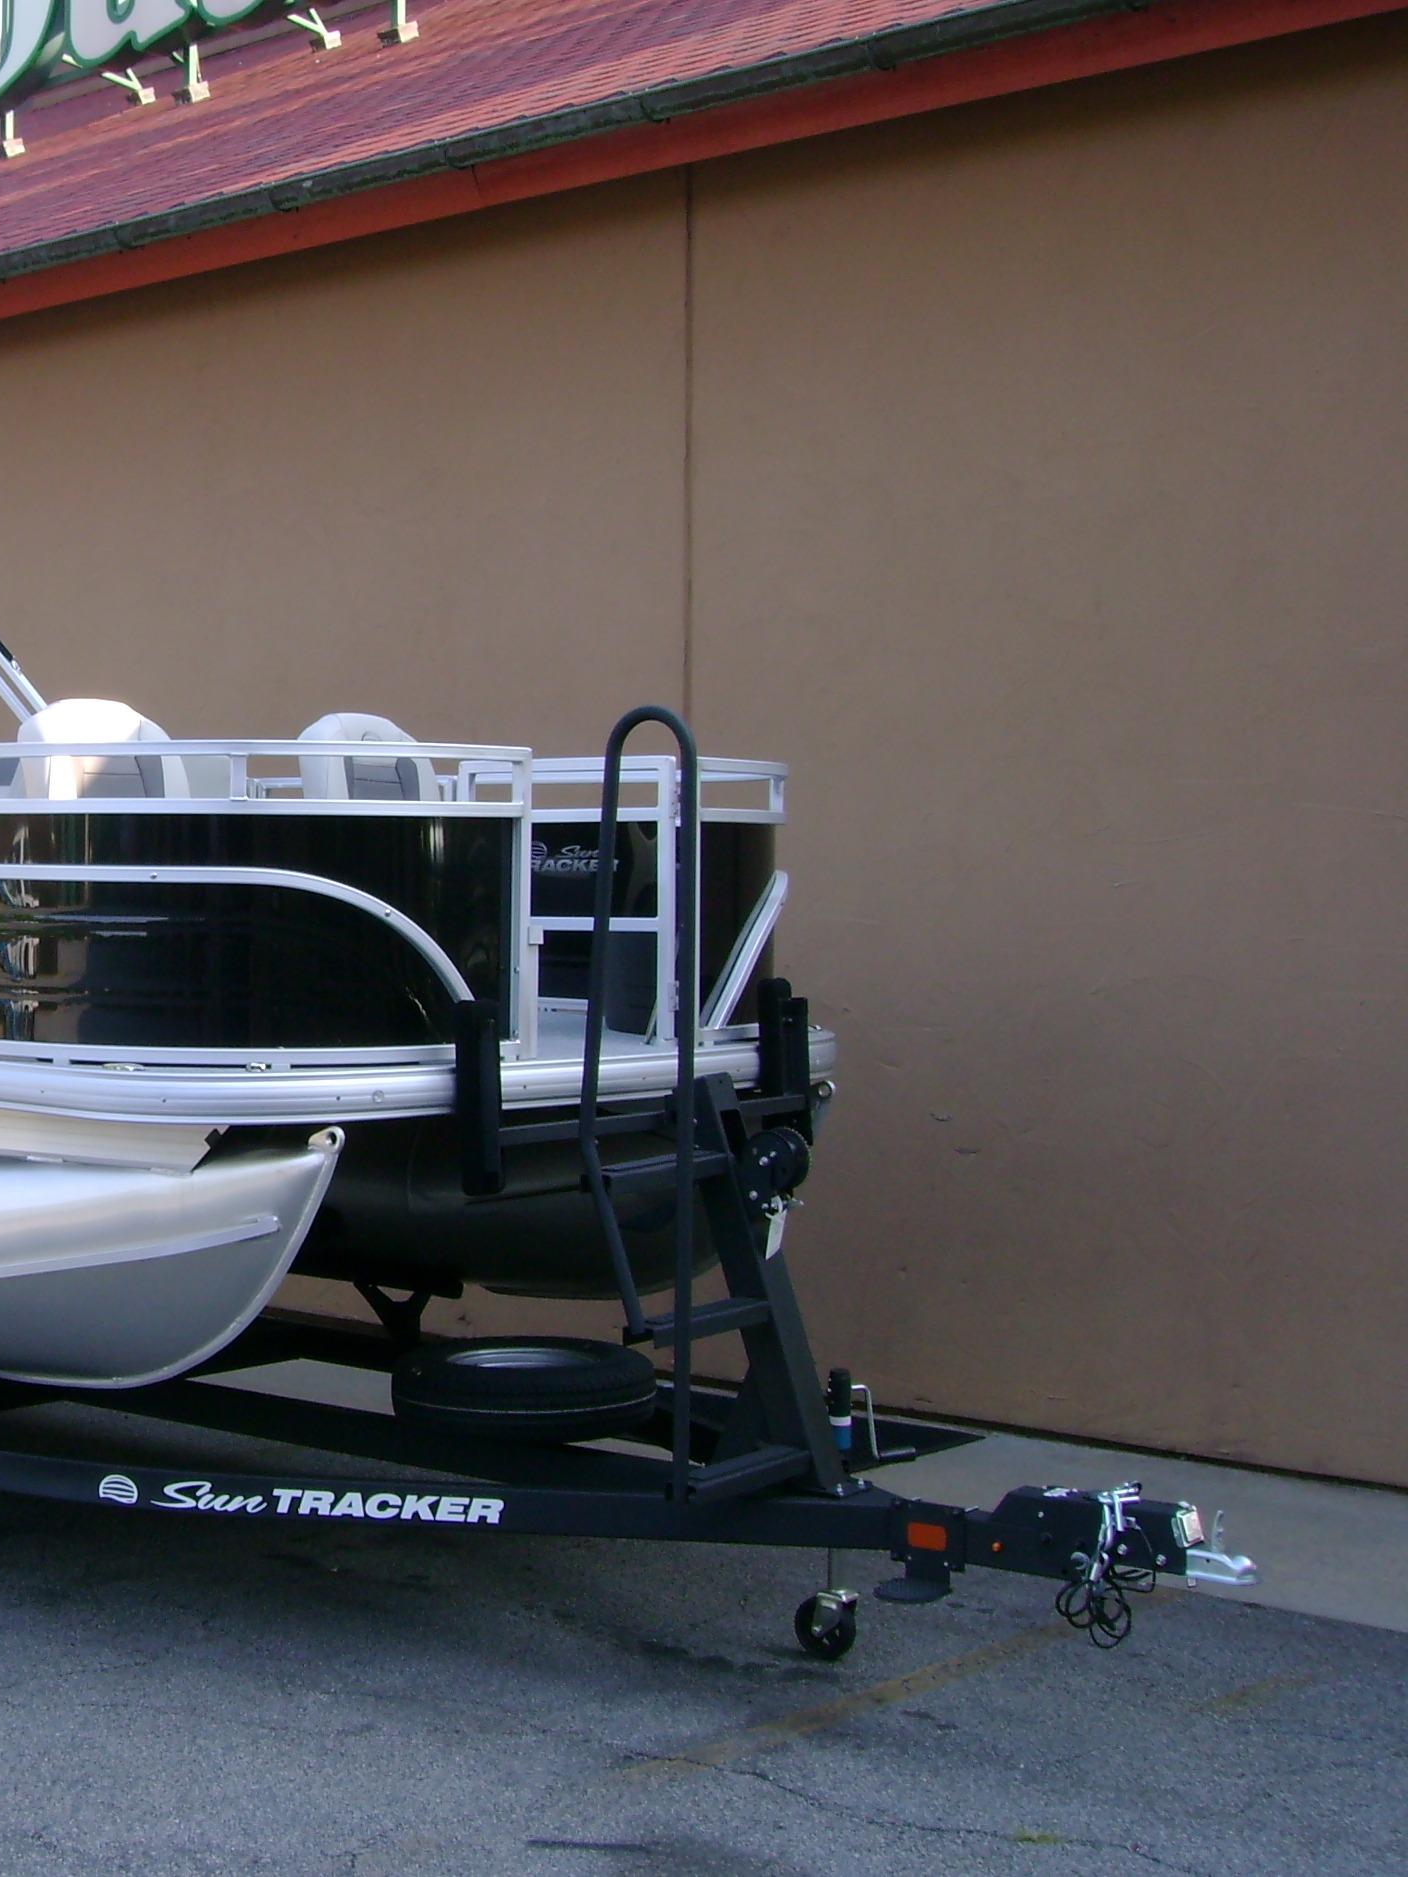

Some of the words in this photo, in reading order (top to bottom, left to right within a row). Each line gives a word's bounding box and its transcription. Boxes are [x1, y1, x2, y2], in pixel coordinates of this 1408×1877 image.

[555, 845, 600, 858] Sun
[531, 859, 619, 872] RACKE
[150, 1481, 268, 1513] Sun
[272, 1488, 504, 1524] TRACKER
